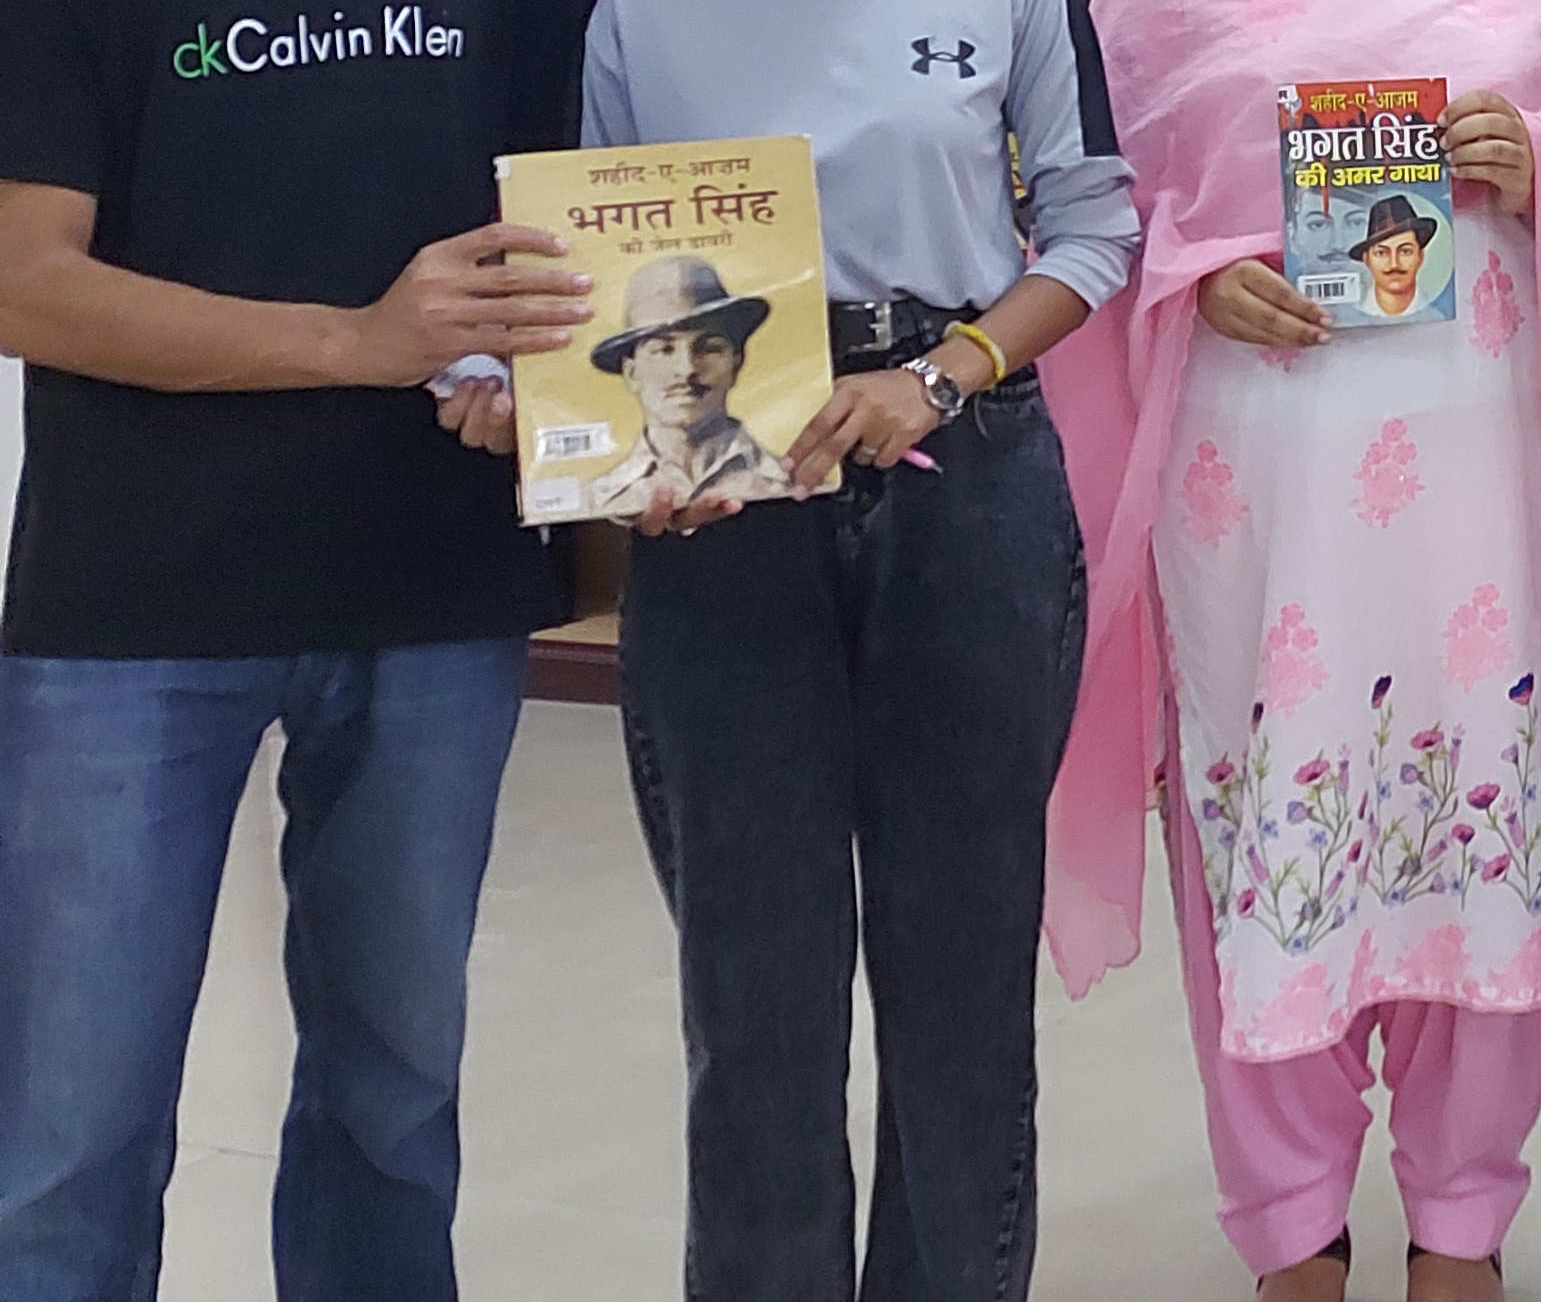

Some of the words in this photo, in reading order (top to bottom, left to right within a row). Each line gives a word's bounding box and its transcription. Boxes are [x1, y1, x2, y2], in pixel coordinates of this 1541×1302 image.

[1288, 127, 1366, 162] भगत
[1371, 113, 1439, 160] सिंह
[1295, 162, 1327, 187] की
[1332, 166, 1386, 187] अमर
[567, 199, 677, 233] भगत
[688, 183, 779, 225] सिंह
